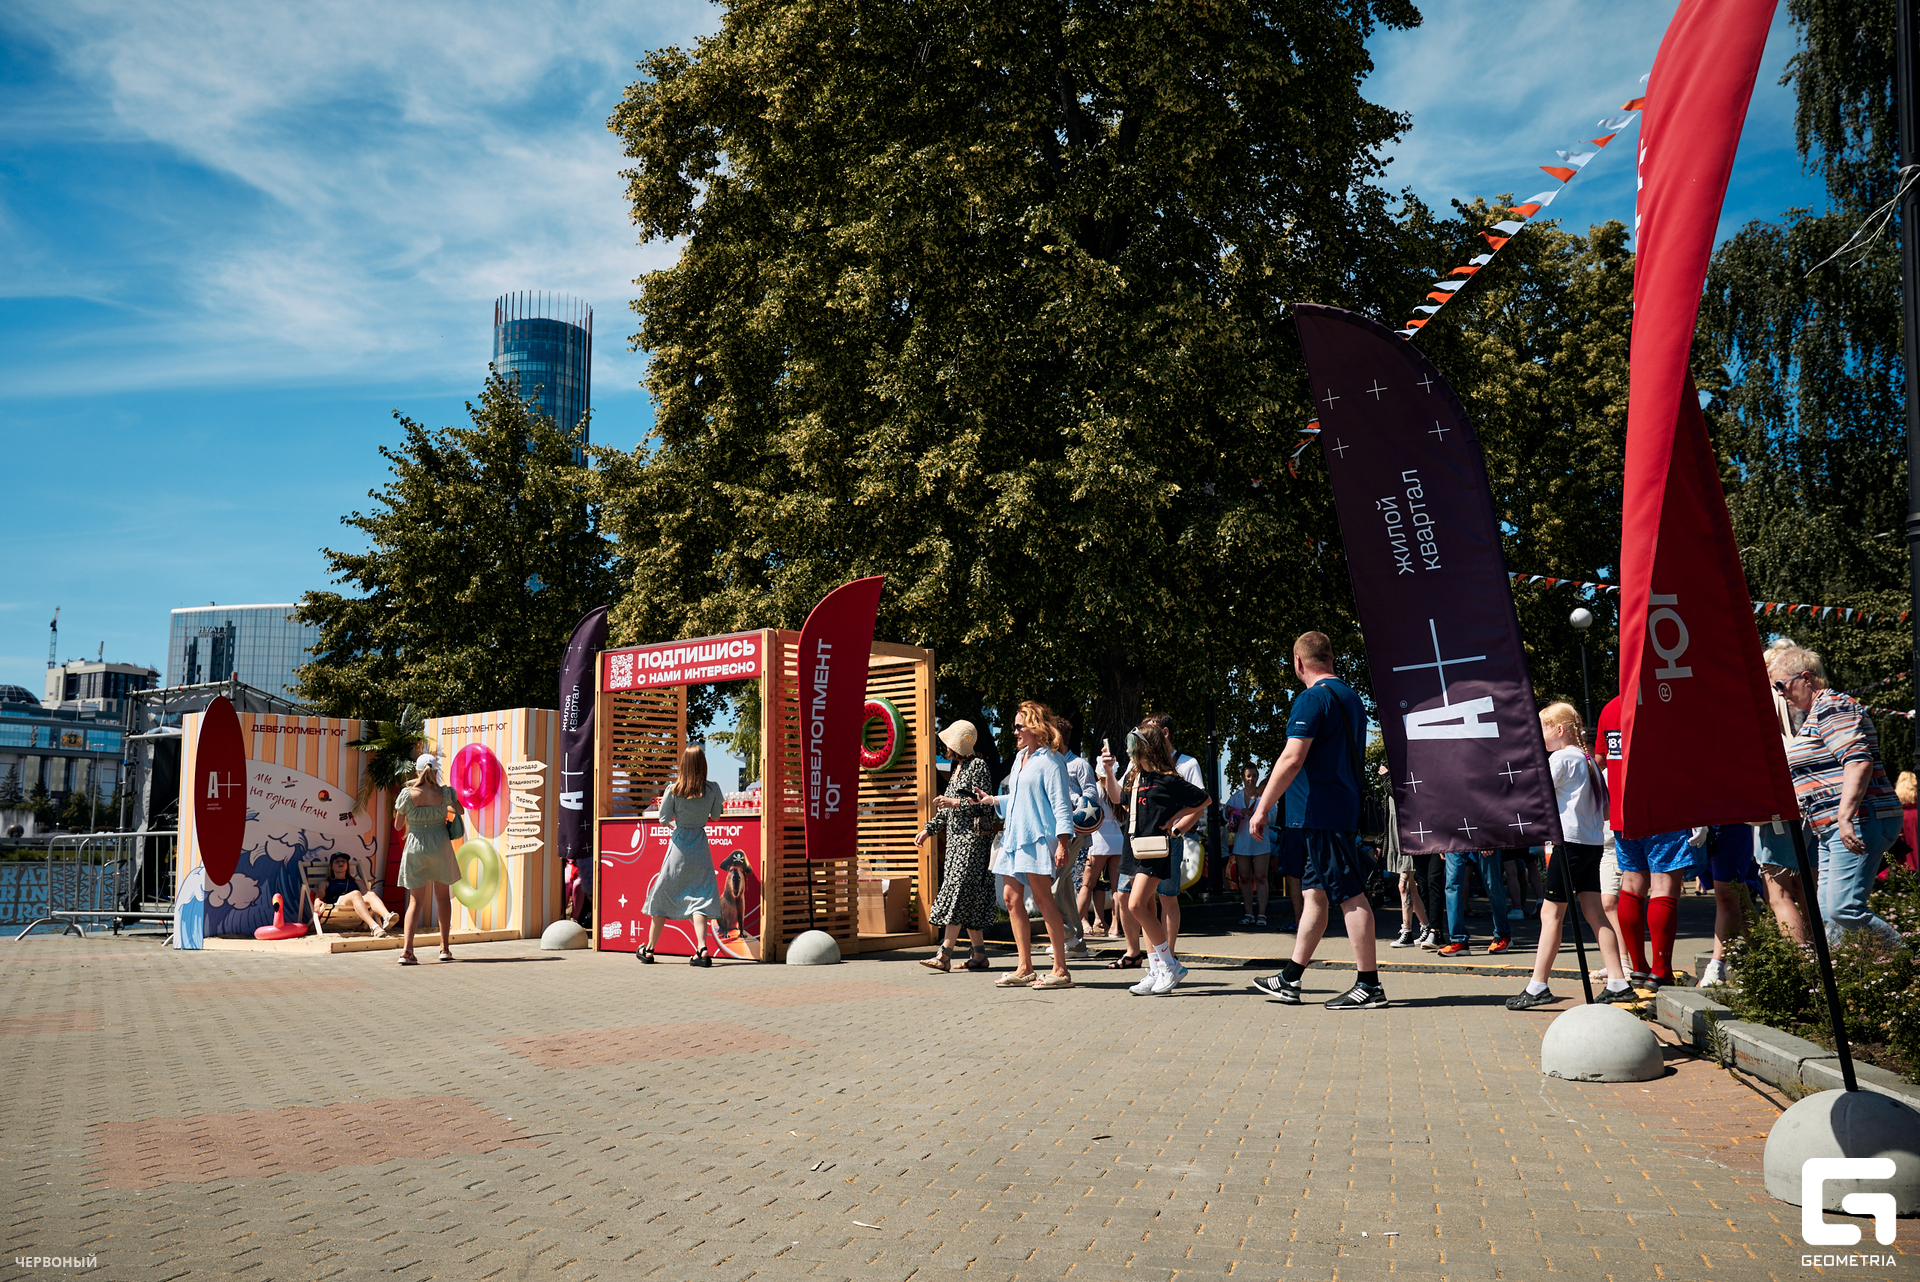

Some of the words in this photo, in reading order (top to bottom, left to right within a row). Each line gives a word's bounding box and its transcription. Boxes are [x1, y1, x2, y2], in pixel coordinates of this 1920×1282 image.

[1401, 469, 1442, 571] квартал
[1375, 496, 1415, 576] жилой
[637, 640, 756, 670] ПОДПИШИСЬ
[637, 674, 646, 685] С
[649, 670, 681, 684] НАМИ
[684, 661, 756, 680] ИНТЕРЕСНО
[562, 695, 571, 732] жилой
[569, 685, 580, 732] квартал
[251, 724, 328, 736] ДЕВЕЛОПМЕНТ
[331, 728, 347, 737] ЮГ
[442, 723, 494, 735] ДЕВЕЛОПМЕНТ
[810, 638, 832, 820] ДЕВЕЛОПМЕНТ
[254, 773, 273, 784] мы
[507, 763, 538, 772] Краснодар
[250, 786, 264, 797] на
[266, 792, 297, 809] одной
[300, 799, 328, 819] волне
[515, 795, 534, 805] Пермь
[825, 776, 841, 812] ЮГ
[511, 842, 538, 850] Астрахань
